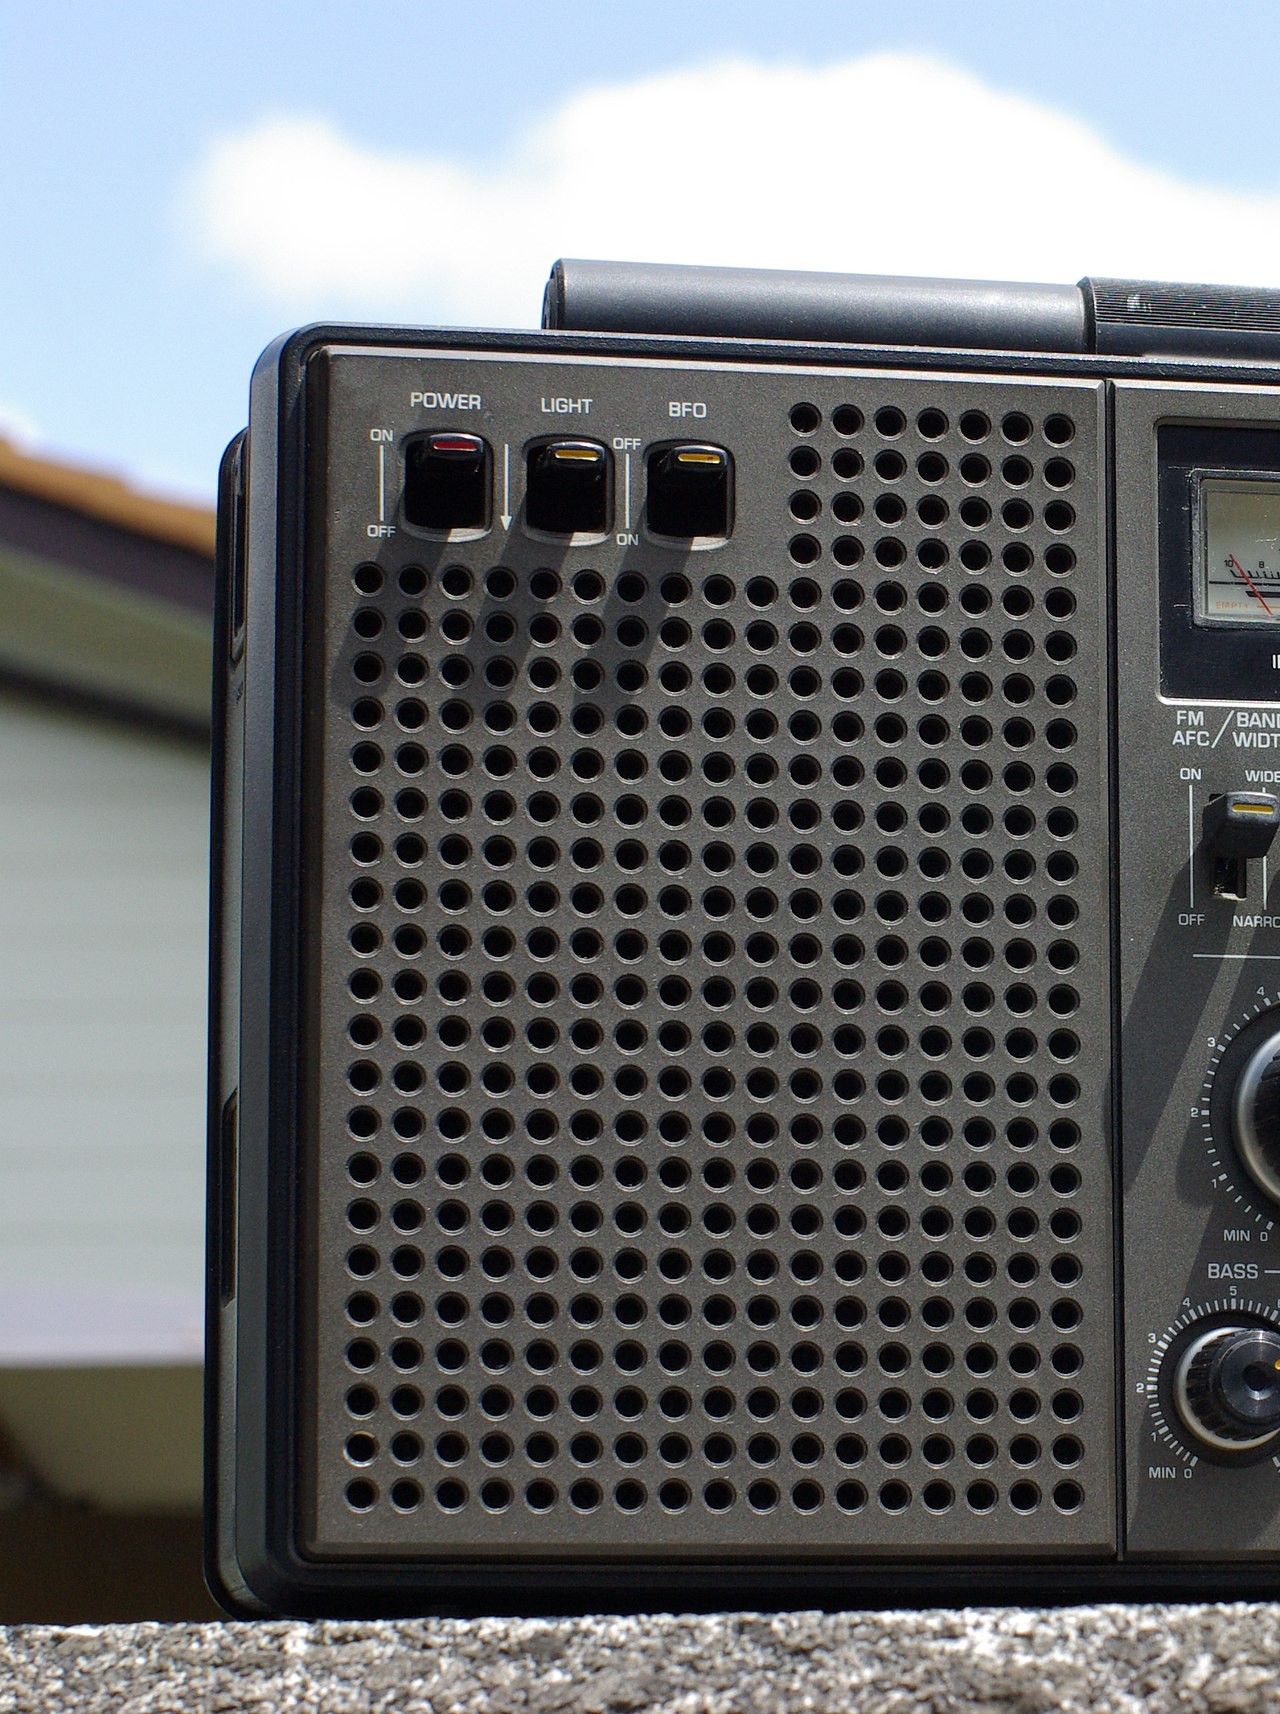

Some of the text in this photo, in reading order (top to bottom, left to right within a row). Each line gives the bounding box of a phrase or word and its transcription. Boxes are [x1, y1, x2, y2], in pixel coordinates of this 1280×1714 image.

[410, 392, 482, 411] POWER
[540, 398, 593, 414] LIGHT
[669, 402, 707, 419] BFO
[370, 429, 394, 442] ON
[613, 437, 641, 451] OFF
[367, 525, 396, 539] OFF
[616, 534, 639, 547] ON
[1224, 559, 1234, 568] 10
[1258, 561, 1265, 569] 8
[1215, 601, 1249, 610] EMPTY
[1176, 711, 1204, 725] FM
[1172, 730, 1210, 747] AFC
[1180, 768, 1202, 780] ON
[1178, 914, 1205, 926] OFF
[1256, 987, 1265, 996] 4
[1207, 1038, 1216, 1047] 3
[1191, 1108, 1199, 1118] 2
[1211, 1179, 1217, 1188] 1
[1223, 1230, 1268, 1242] MIN 0
[1208, 1263, 1259, 1280] BASS
[1148, 1467, 1192, 1480] MIN 0
